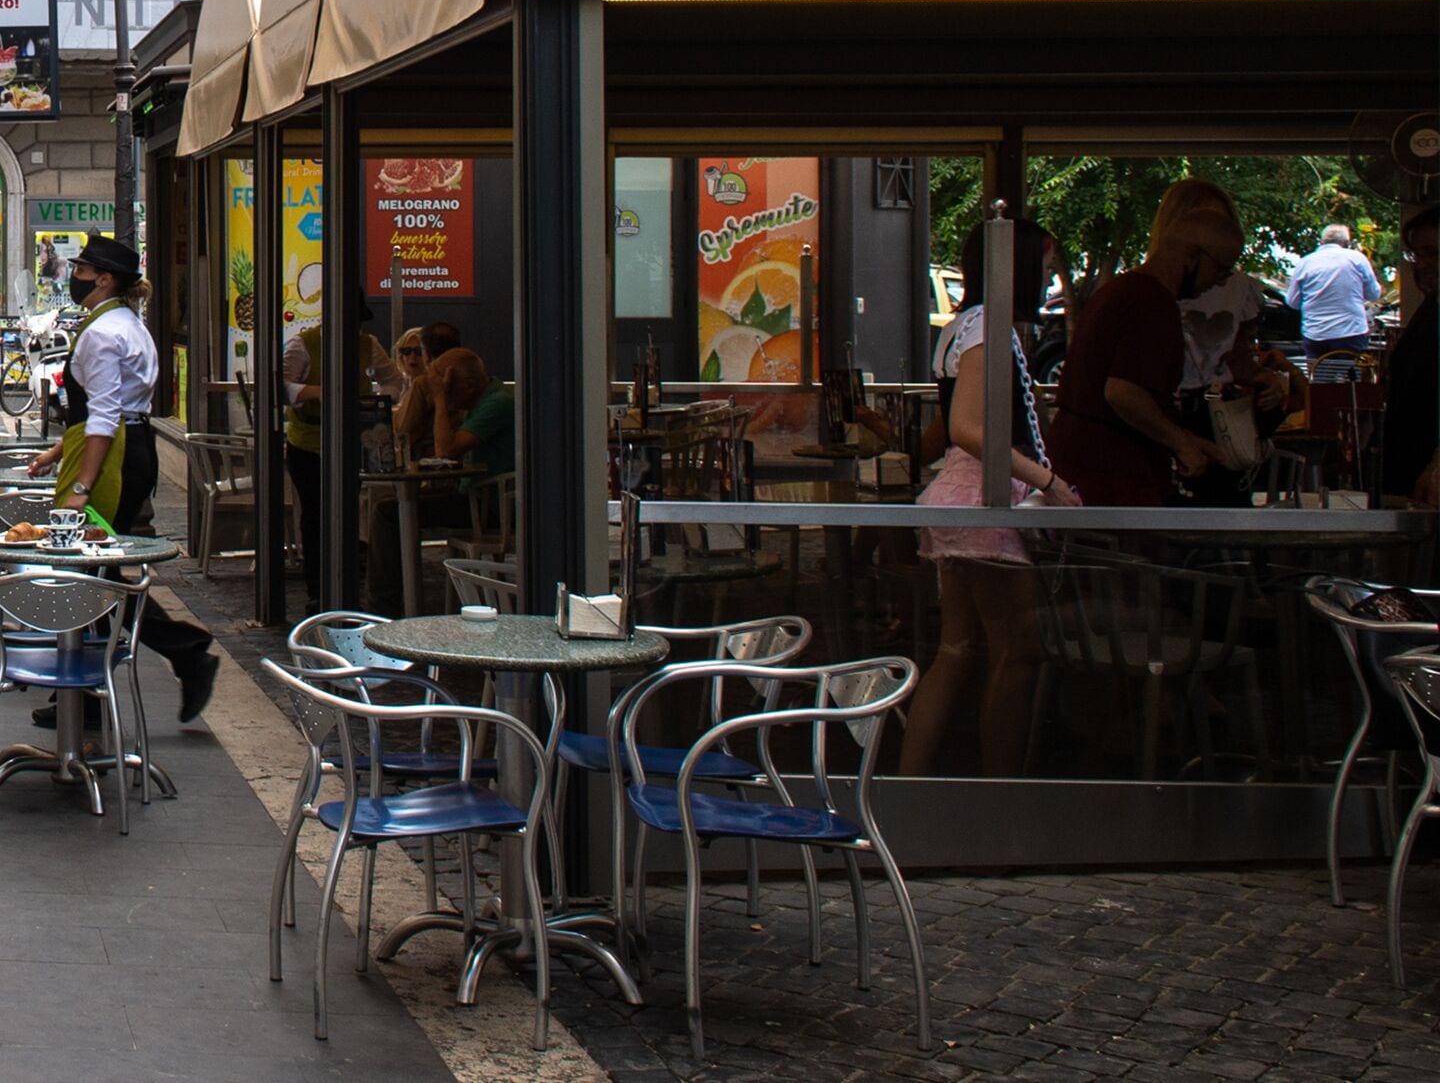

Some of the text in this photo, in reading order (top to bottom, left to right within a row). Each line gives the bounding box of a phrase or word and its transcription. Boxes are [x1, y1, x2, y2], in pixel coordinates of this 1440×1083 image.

[378, 199, 460, 210] MELOGRANO
[394, 214, 445, 229] 100%
[699, 193, 818, 264] Spremute
[380, 279, 391, 288] di
